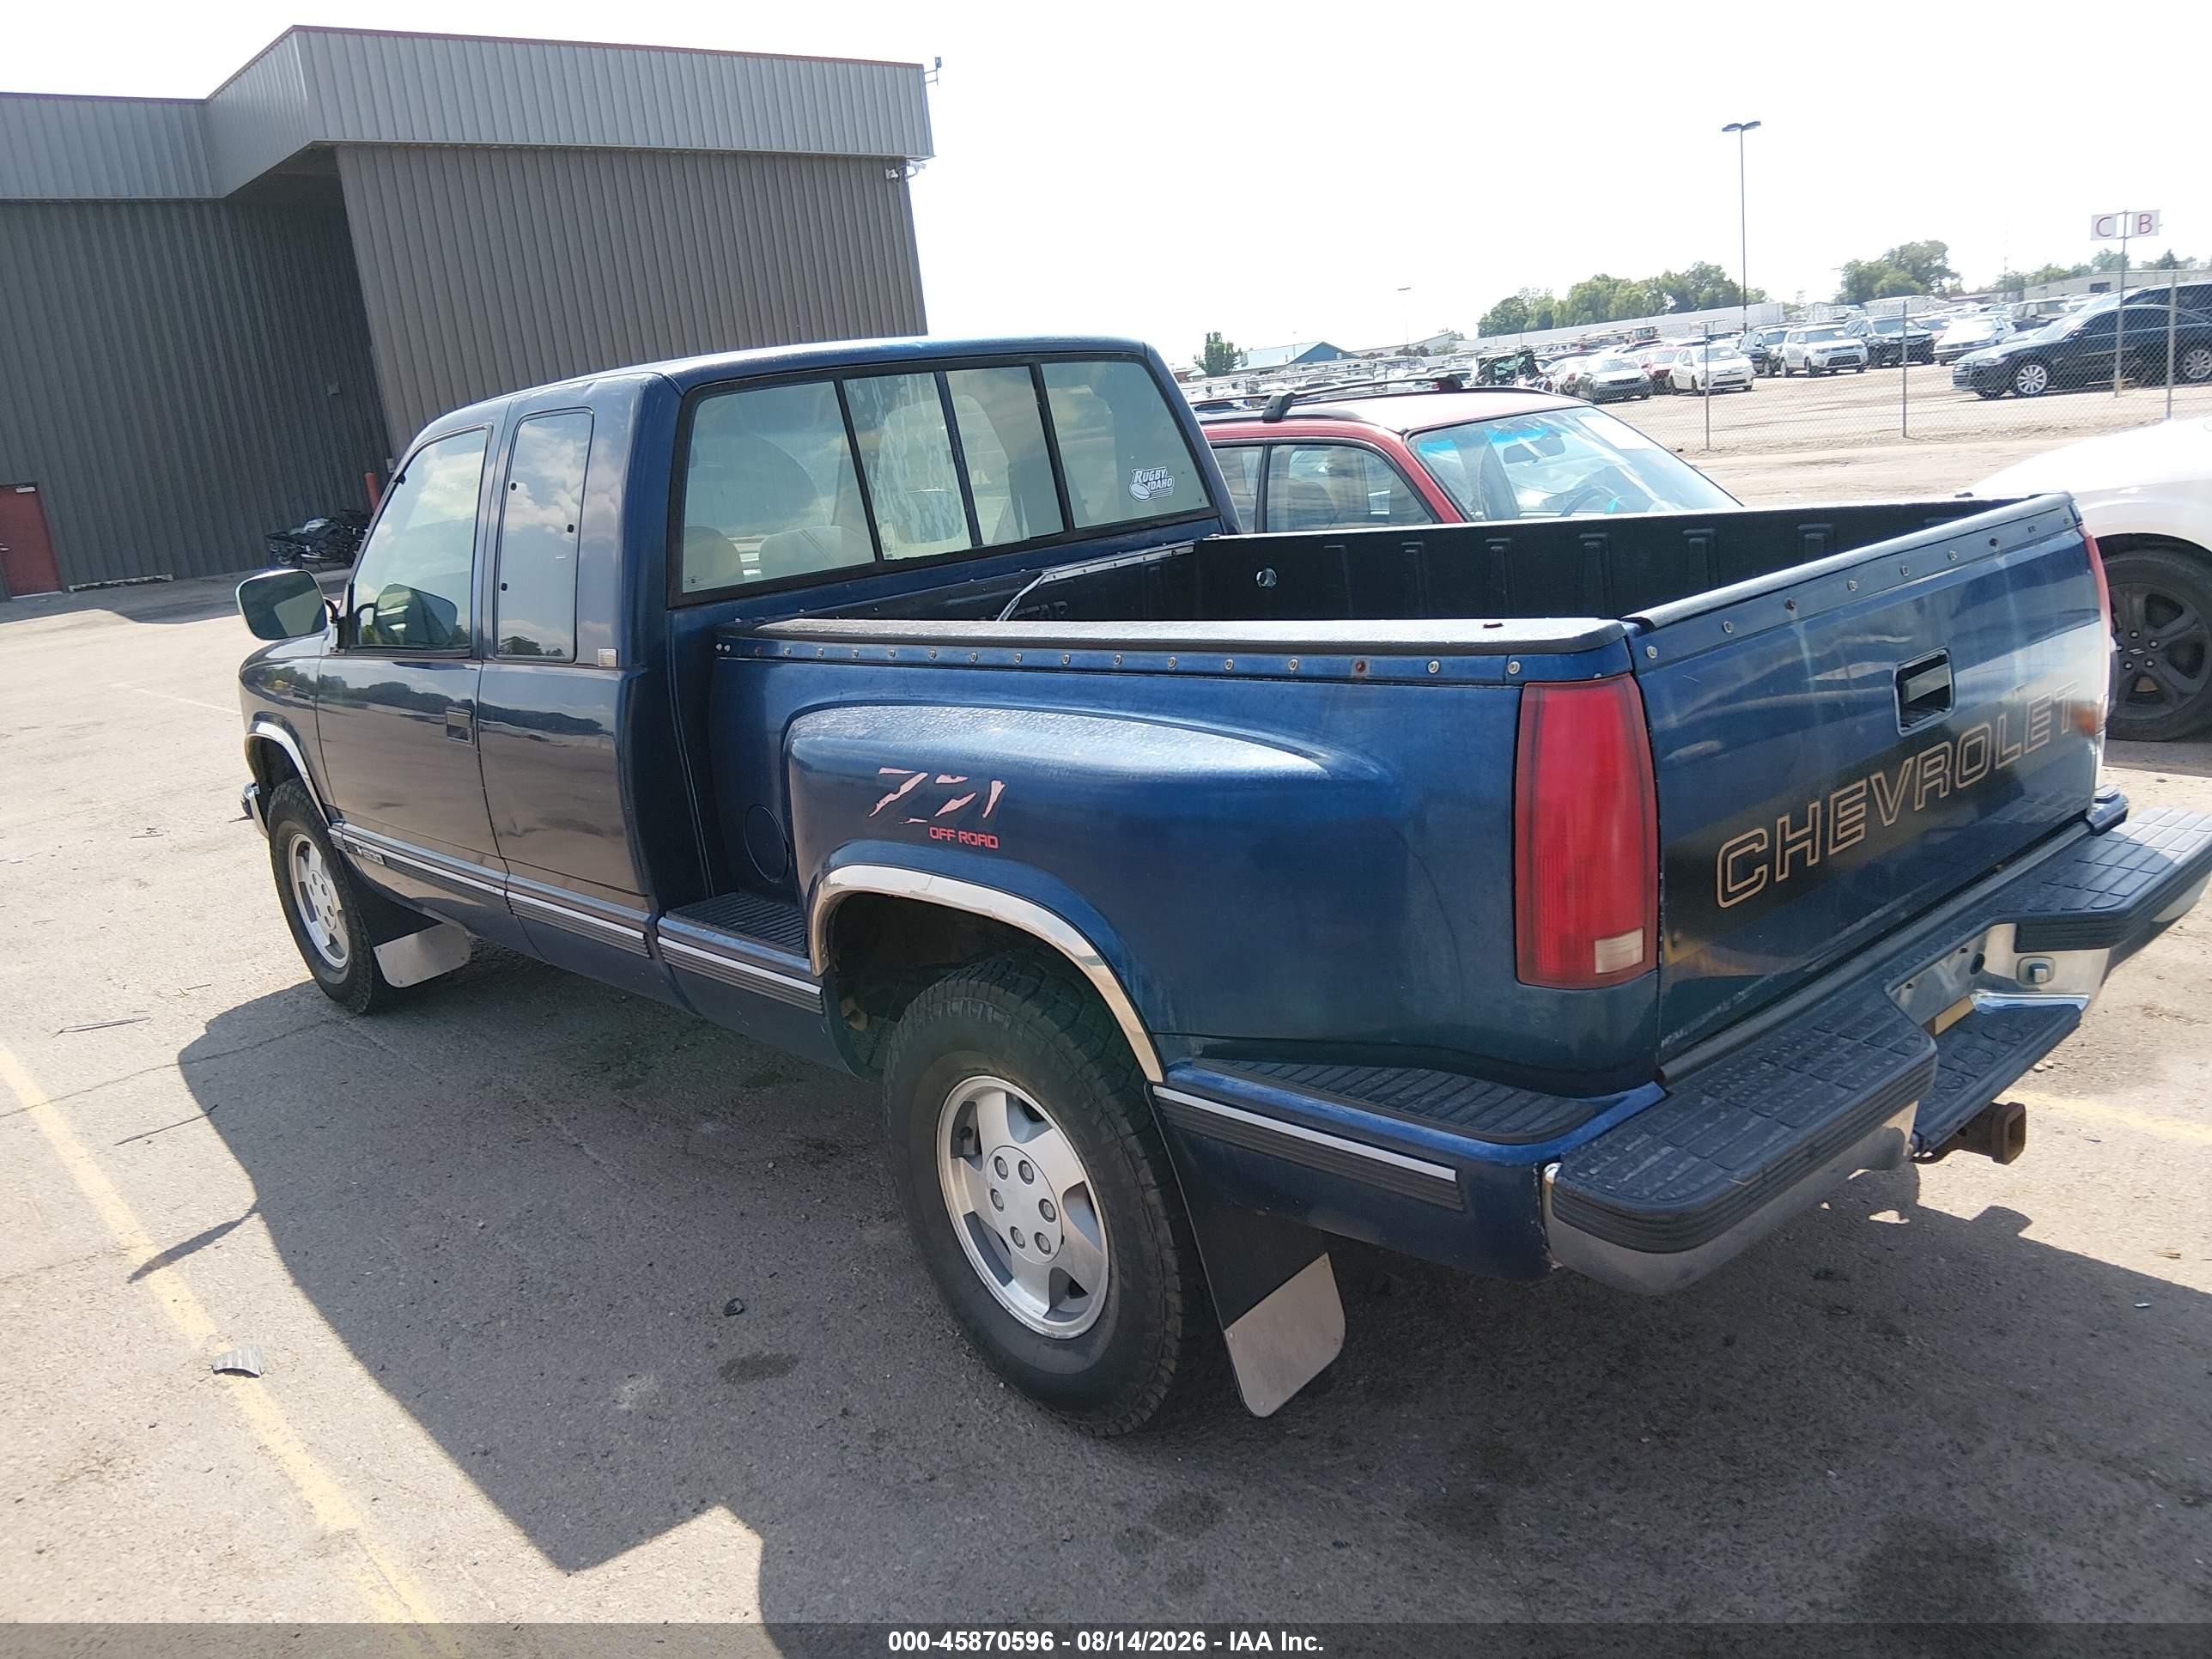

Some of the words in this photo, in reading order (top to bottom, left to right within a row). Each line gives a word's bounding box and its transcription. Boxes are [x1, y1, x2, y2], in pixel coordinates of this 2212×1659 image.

[2096, 216, 2112, 238] C
[2138, 214, 2154, 235] B
[1133, 469, 1167, 483] RUGBY
[1146, 477, 1173, 490] IDAHO
[1717, 678, 2081, 908] CHEVROLET
[929, 826, 956, 842] OFF
[958, 830, 999, 849] ROAD
